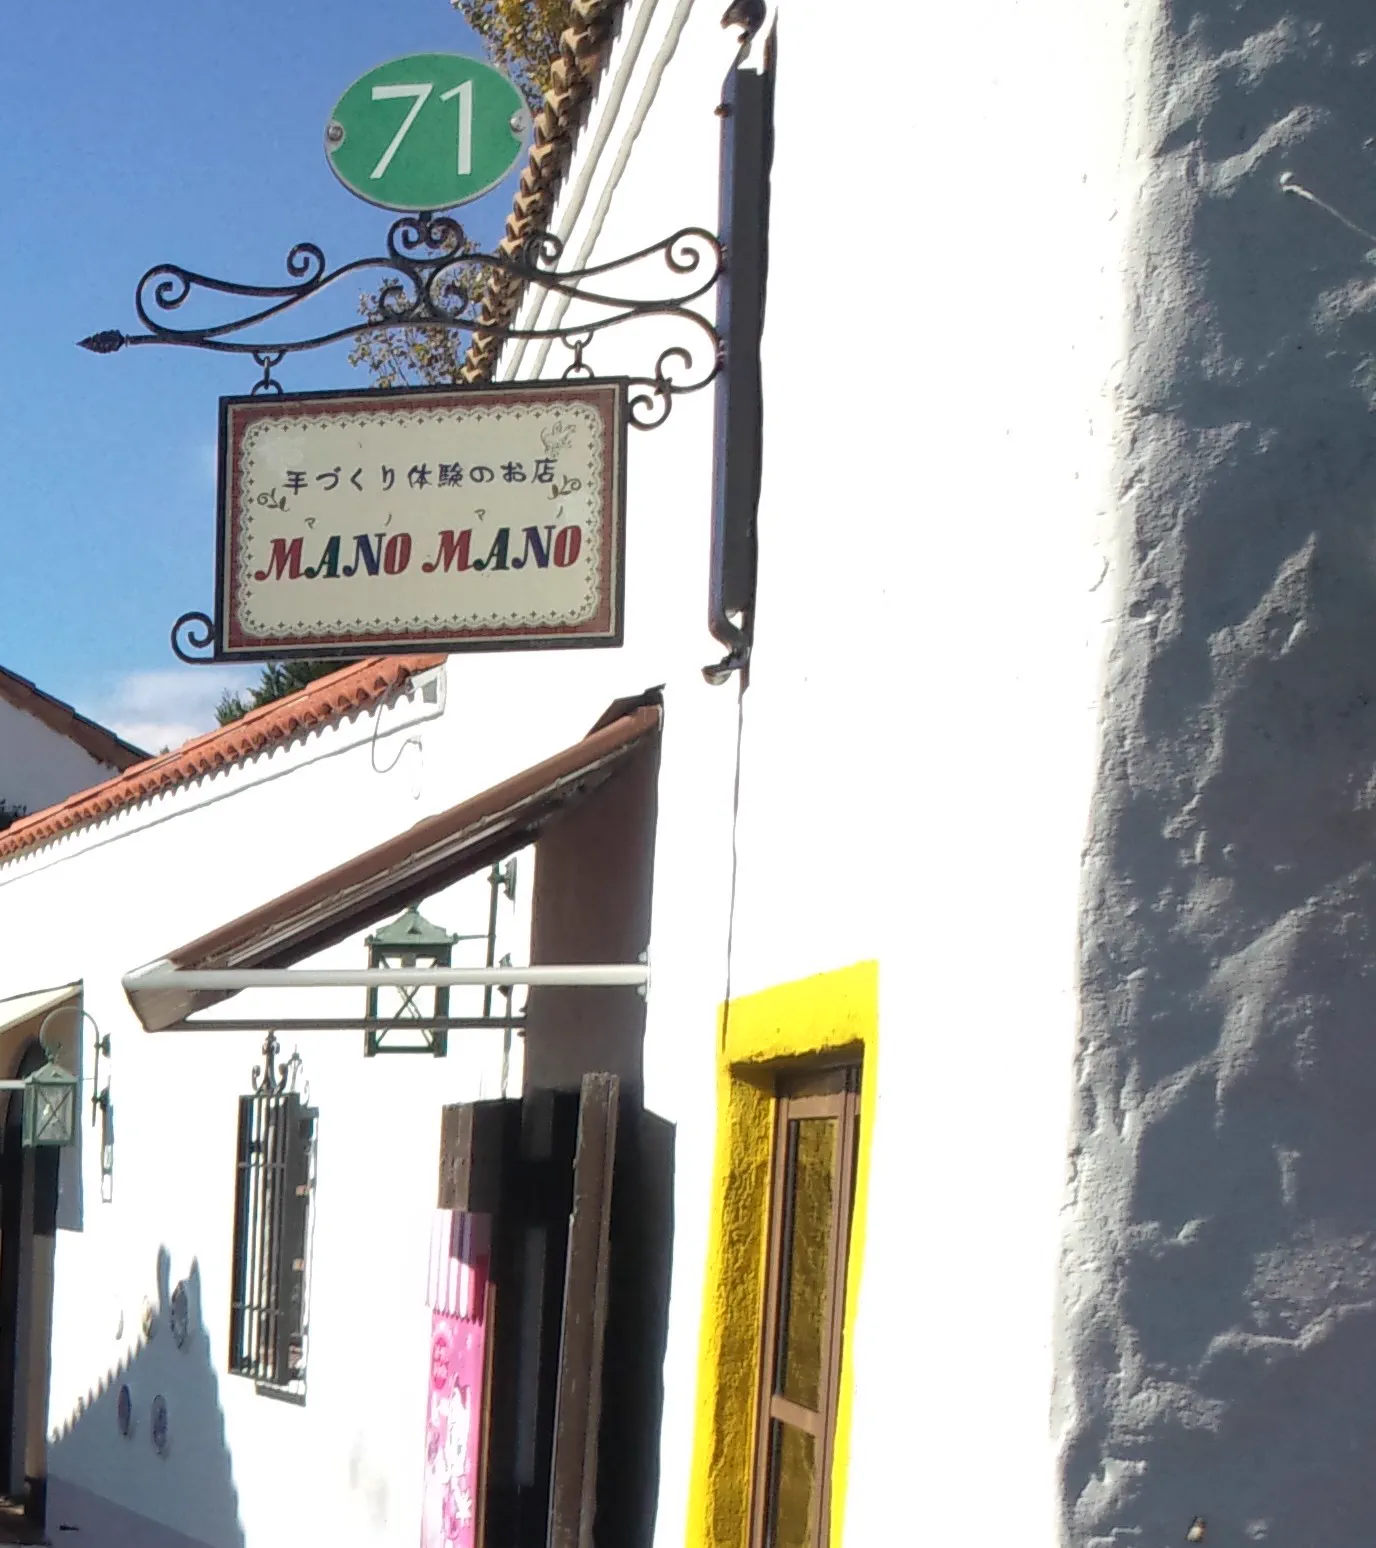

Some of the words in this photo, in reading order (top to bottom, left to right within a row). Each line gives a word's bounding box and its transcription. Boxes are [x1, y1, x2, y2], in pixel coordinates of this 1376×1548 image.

[369, 79, 473, 179] 71
[282, 458, 559, 495] 手づくり体験のお店
[254, 532, 412, 581] MANO
[421, 524, 583, 573] MANO
